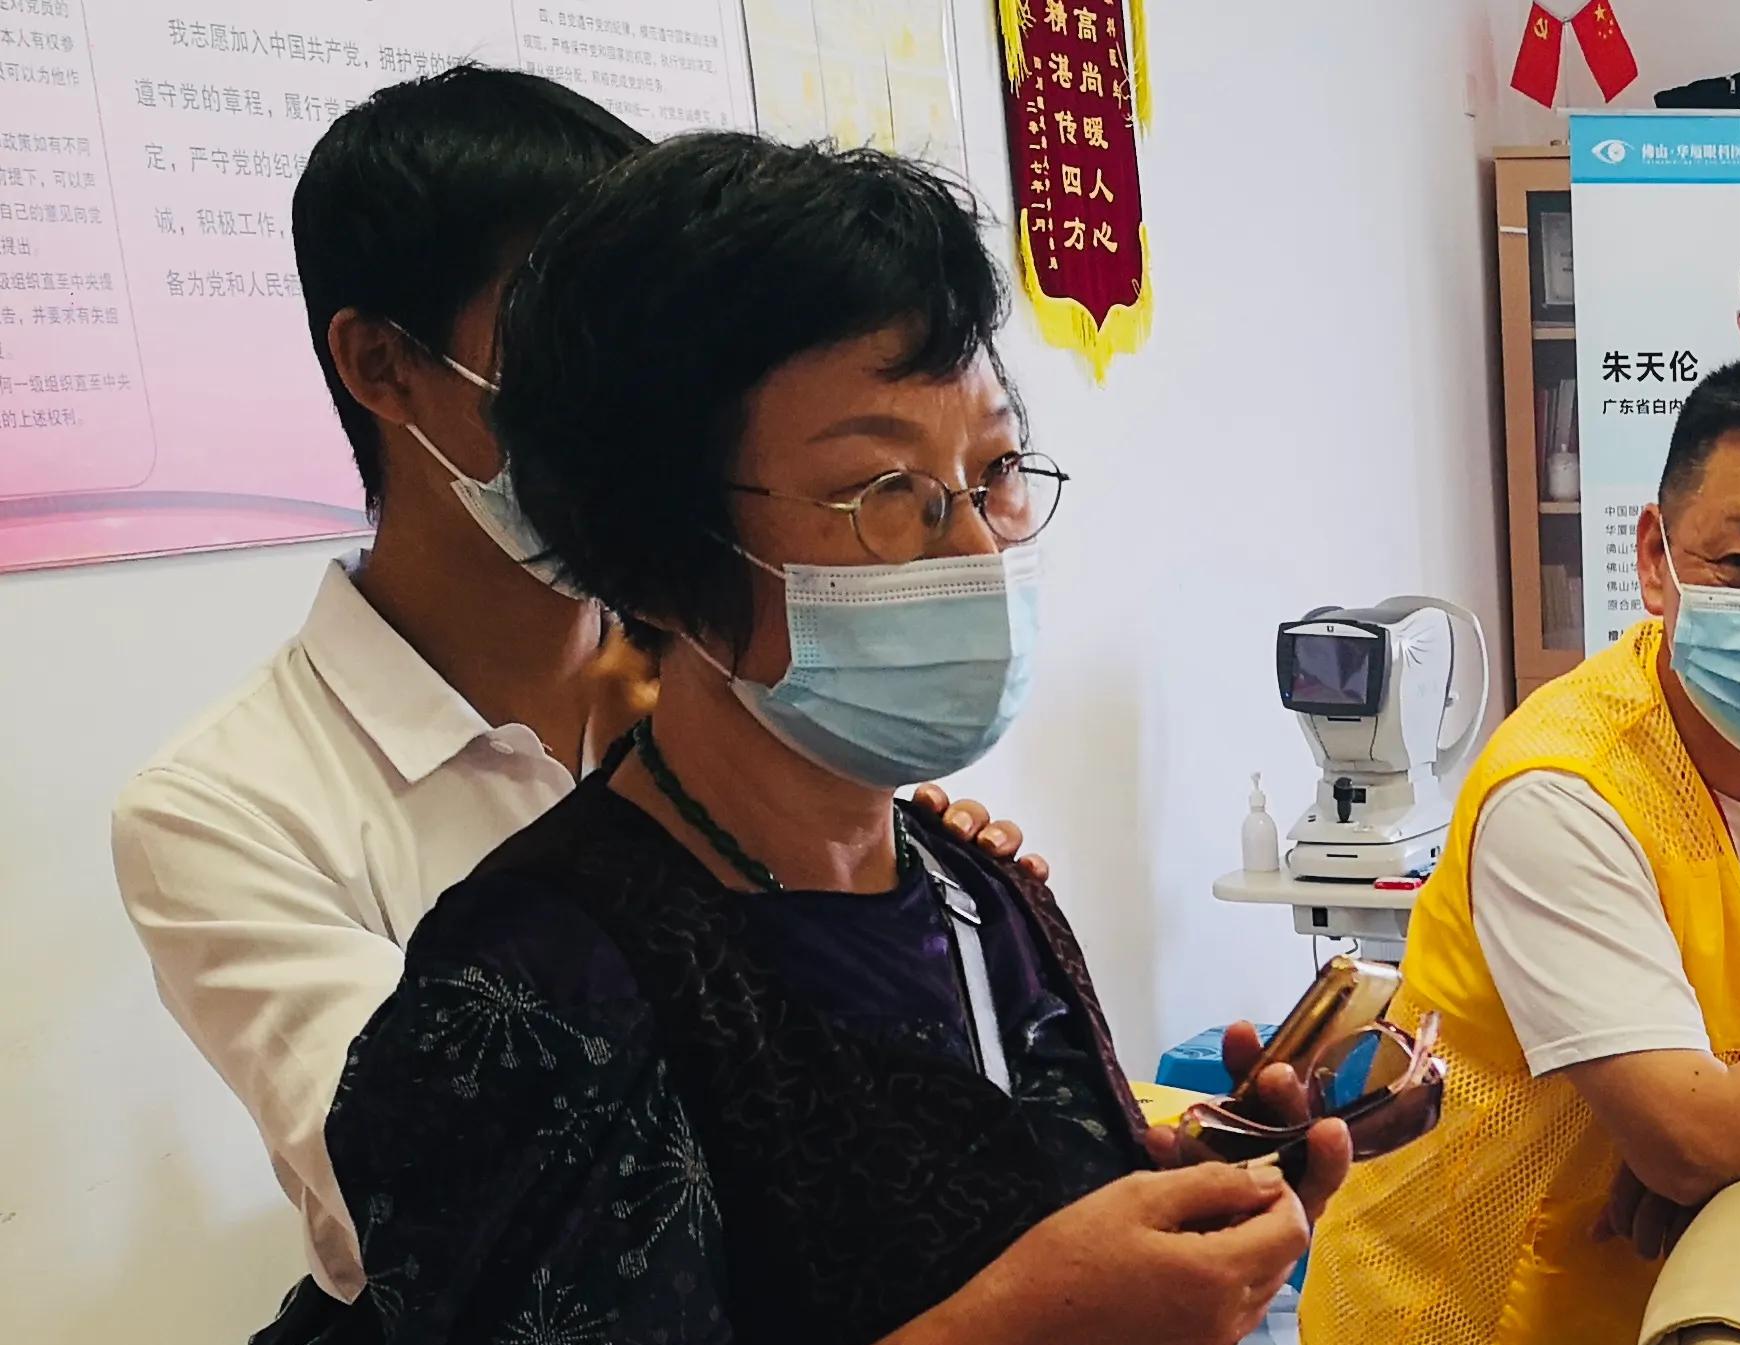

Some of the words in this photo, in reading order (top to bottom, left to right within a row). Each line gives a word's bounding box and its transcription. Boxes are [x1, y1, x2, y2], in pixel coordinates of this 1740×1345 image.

[0, 0, 69, 18] 对党员的
[1044, 0, 1086, 250] 精湛传四方
[1074, 6, 1118, 253] 高尚暖人心
[0, 132, 90, 156] 政策如有不同
[0, 235, 39, 257] 提出。
[0, 306, 119, 326] 告，并要求有关组
[1602, 350, 1699, 383] 朱天伦
[1602, 398, 1683, 415] 广东省白内
[0, 408, 83, 429] 的上述权利。
[1605, 505, 1643, 517] 中国眼
